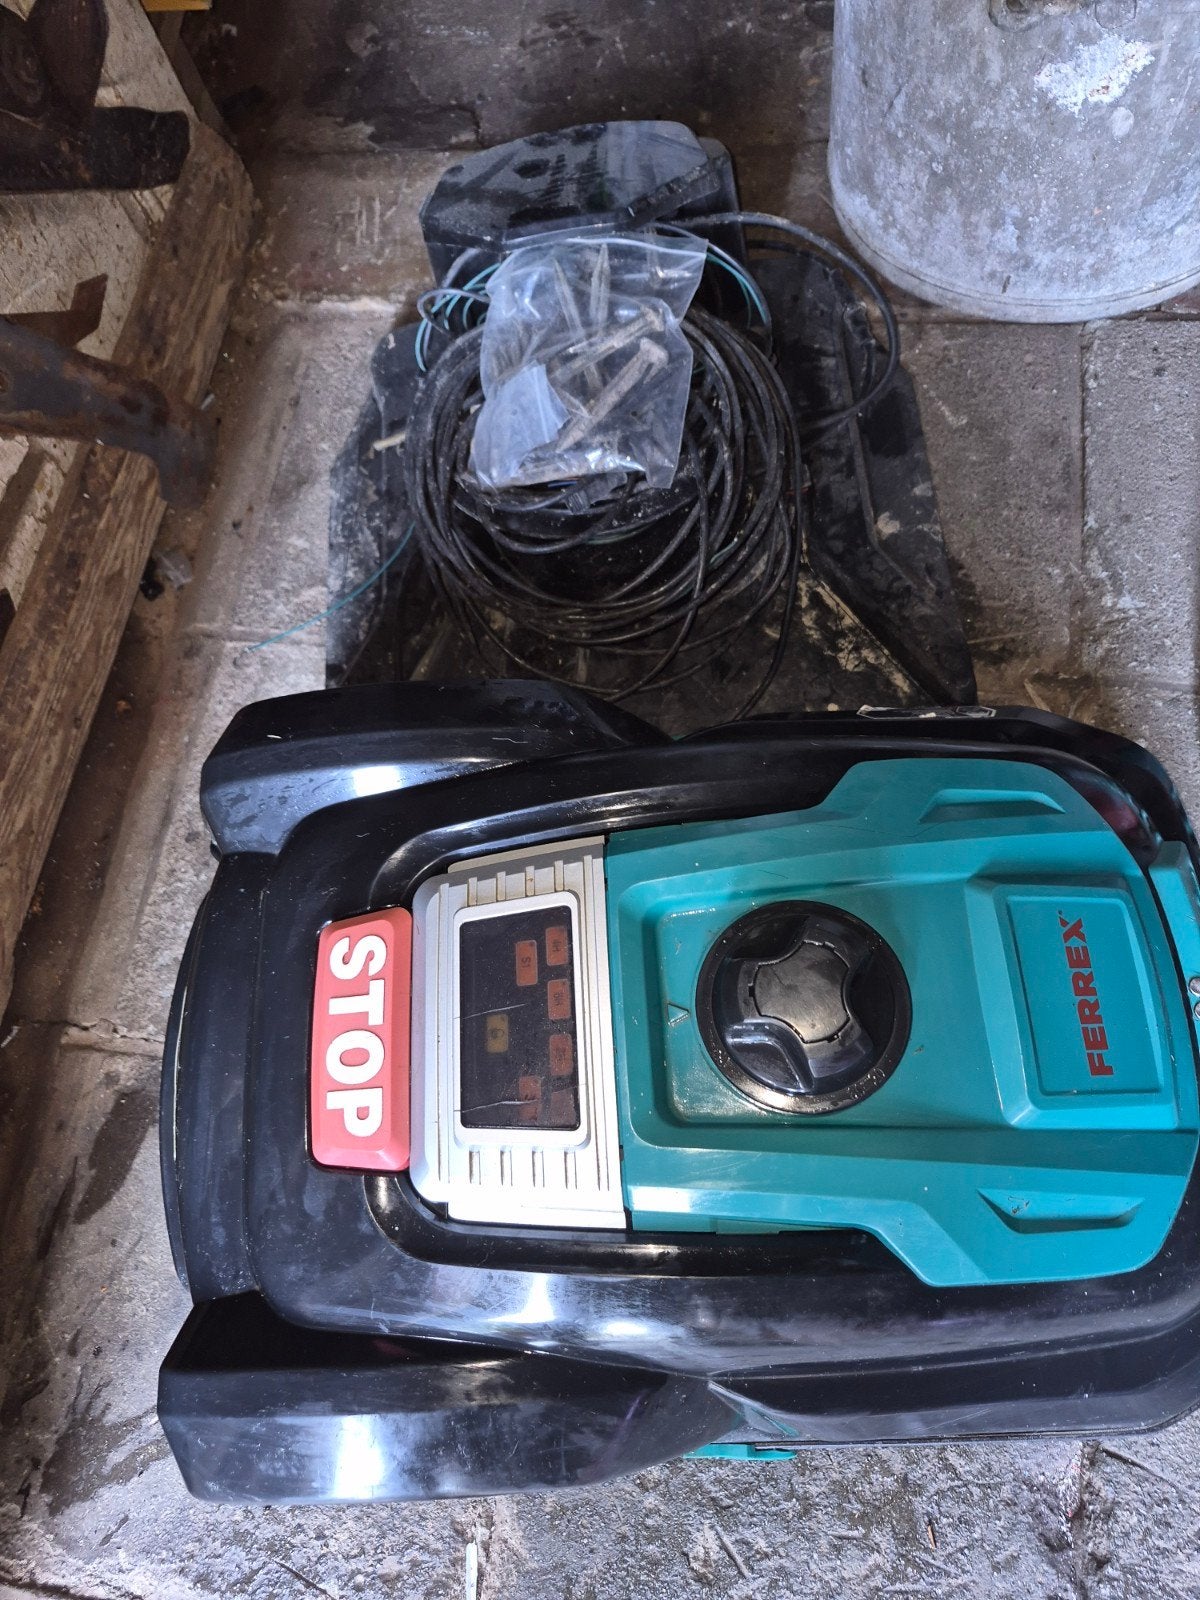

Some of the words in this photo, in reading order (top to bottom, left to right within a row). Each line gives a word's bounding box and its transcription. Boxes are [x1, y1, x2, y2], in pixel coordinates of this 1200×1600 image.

[326, 935, 388, 1138] STOP
[521, 956, 532, 969] S1
[1059, 916, 1114, 1077] FERREX
